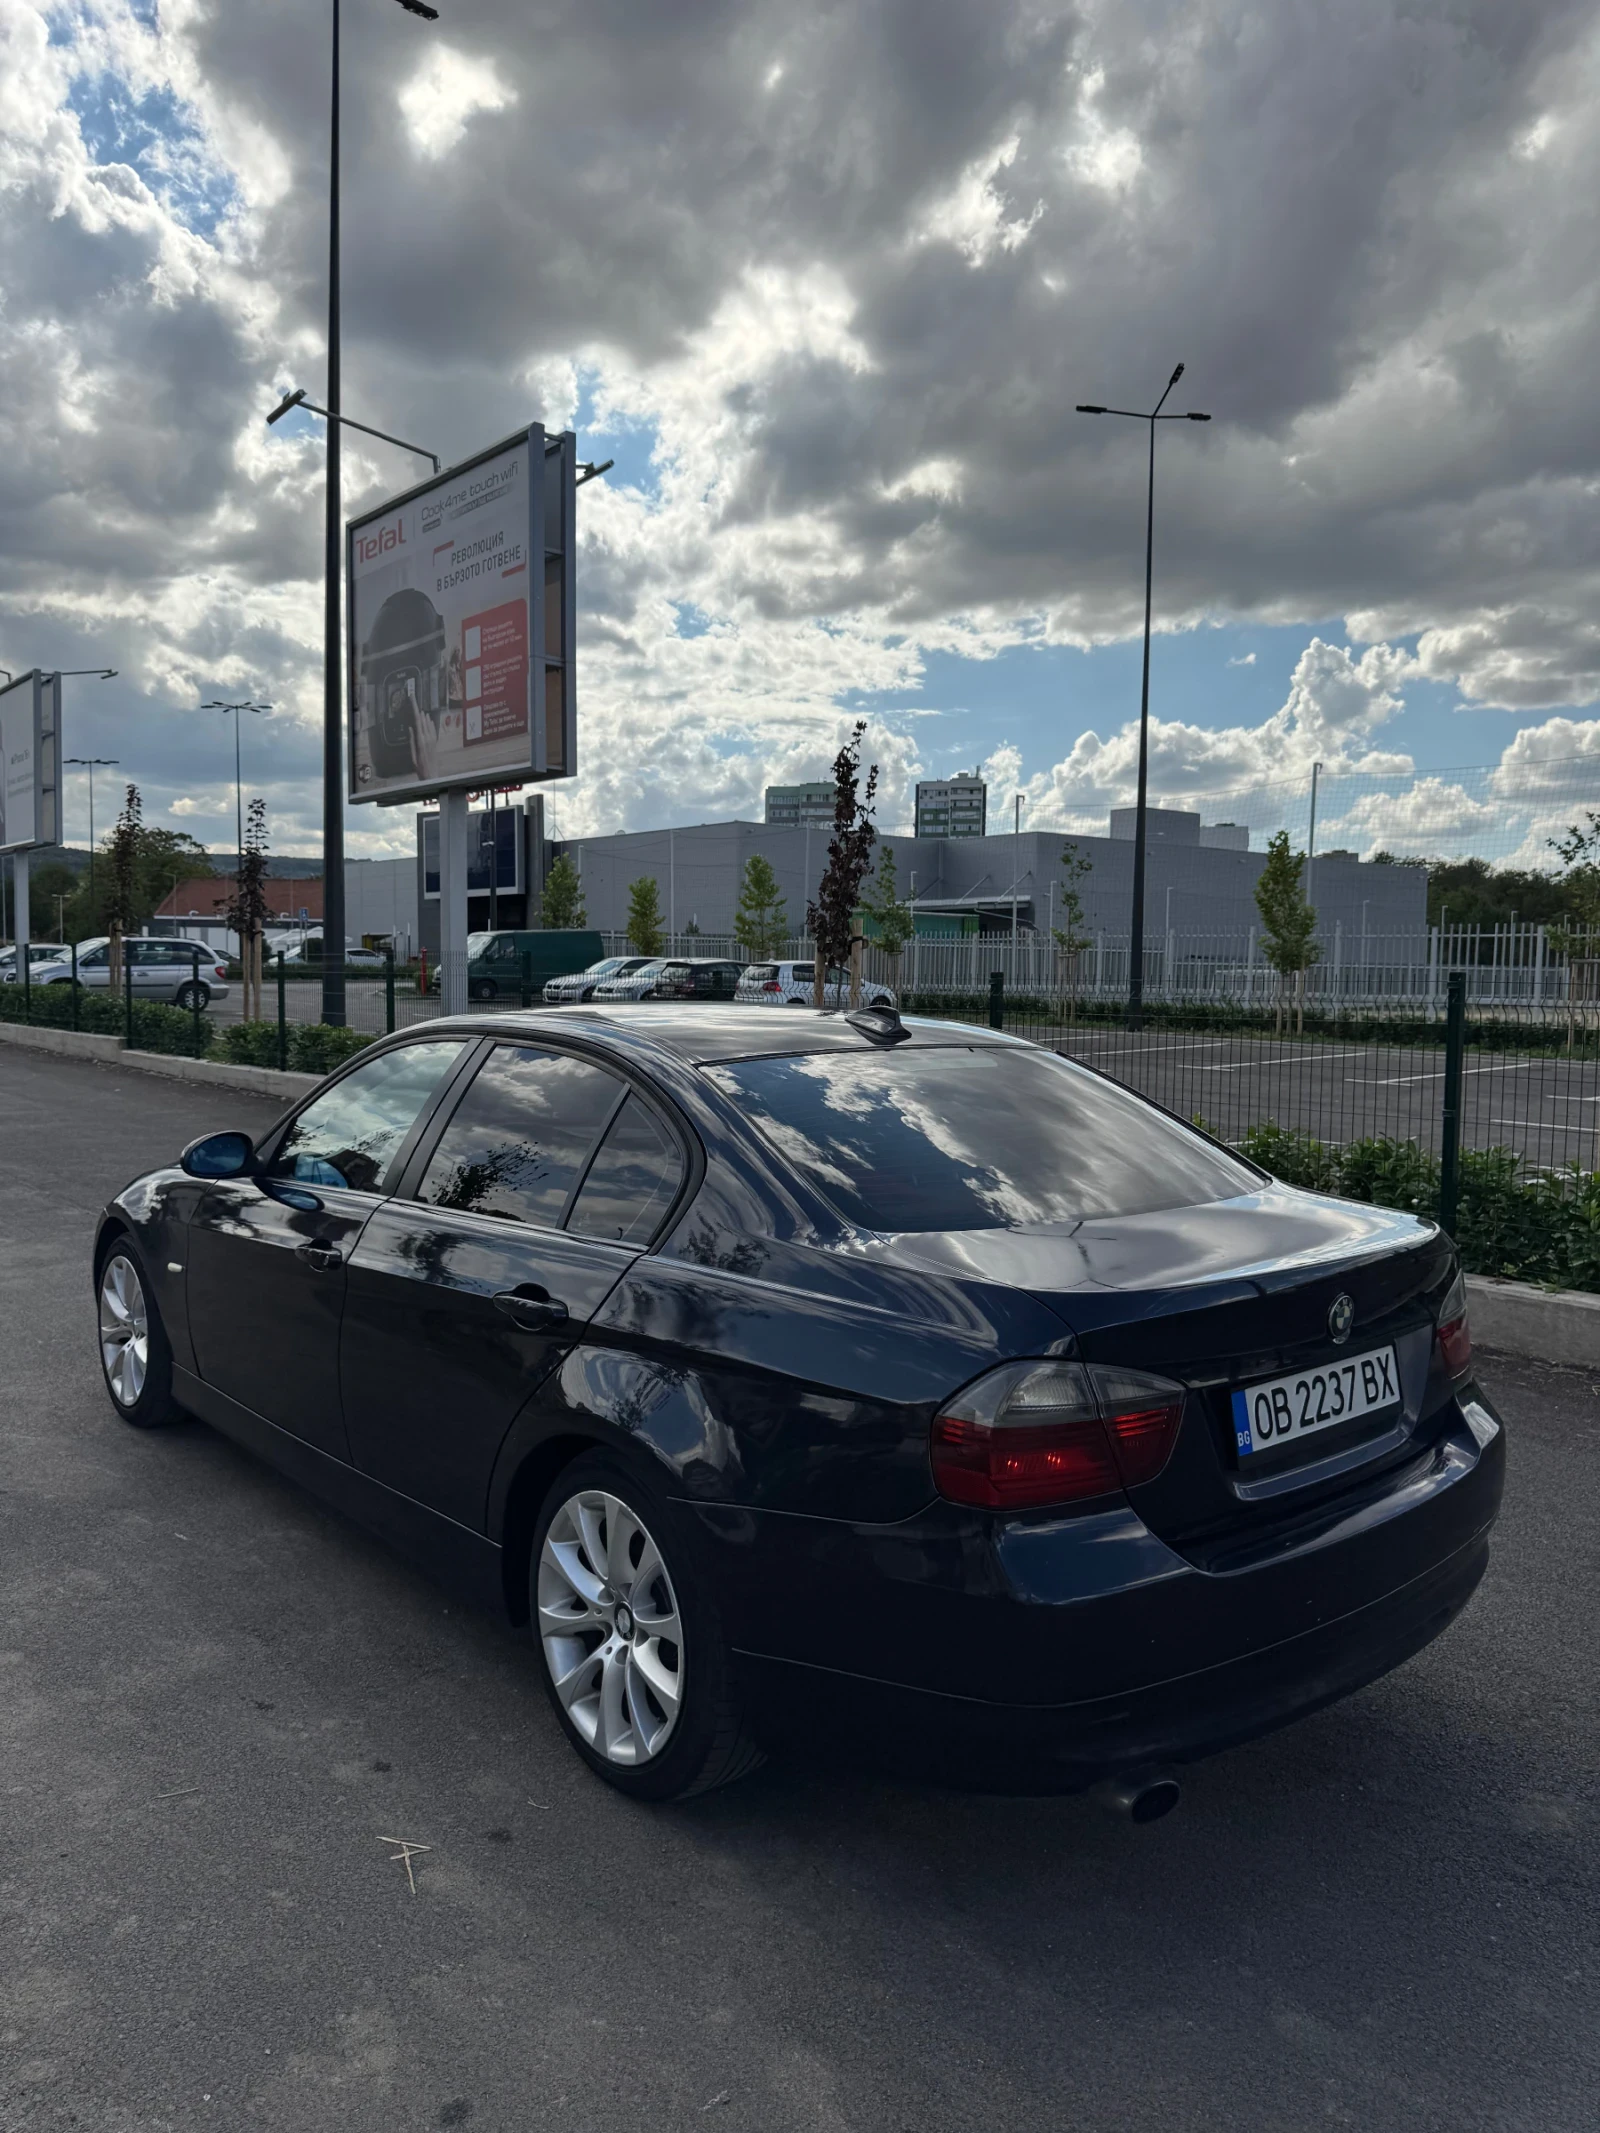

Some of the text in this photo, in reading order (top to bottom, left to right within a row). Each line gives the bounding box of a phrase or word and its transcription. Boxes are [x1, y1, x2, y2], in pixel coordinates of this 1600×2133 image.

[421, 490, 467, 521] Cook4me
[469, 473, 499, 497] touch
[500, 461, 519, 482] wifi
[356, 518, 407, 564] Tefal
[451, 530, 504, 567] РЕВОЛЮЦИЯ
[436, 544, 521, 592] В БЪРЗОТО ГОТВЕНЕ
[1237, 1353, 1395, 1447] BG OB 2237 BX
